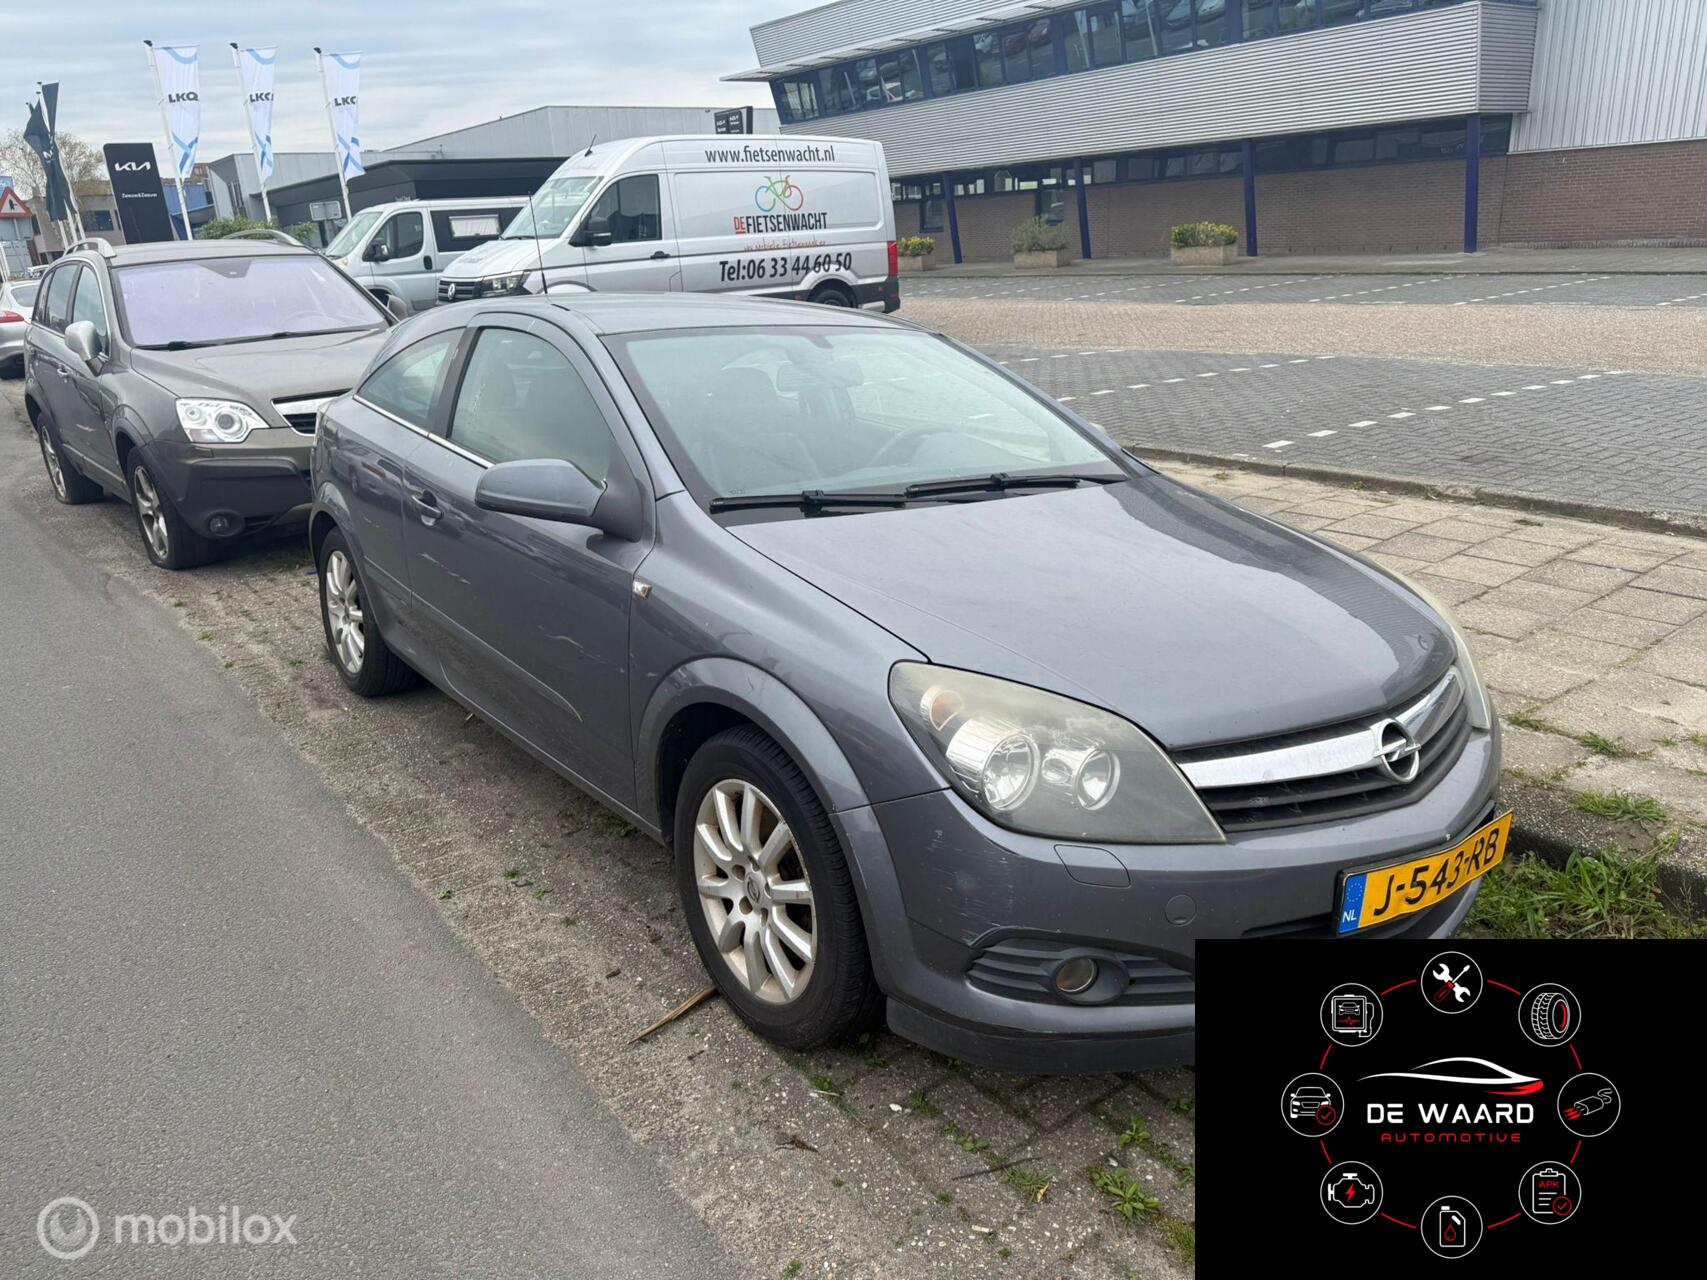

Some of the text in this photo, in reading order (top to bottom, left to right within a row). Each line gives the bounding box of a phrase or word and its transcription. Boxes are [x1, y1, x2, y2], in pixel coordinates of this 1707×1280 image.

[168, 91, 199, 104] LKQ
[705, 145, 835, 163] www.fietsenwacht.nl
[769, 257, 788, 278] 33
[791, 255, 810, 276] 44
[813, 252, 832, 274] 60
[834, 251, 852, 272] 50
[1373, 828, 1500, 916] J-543-RB
[1342, 909, 1358, 923] NL
